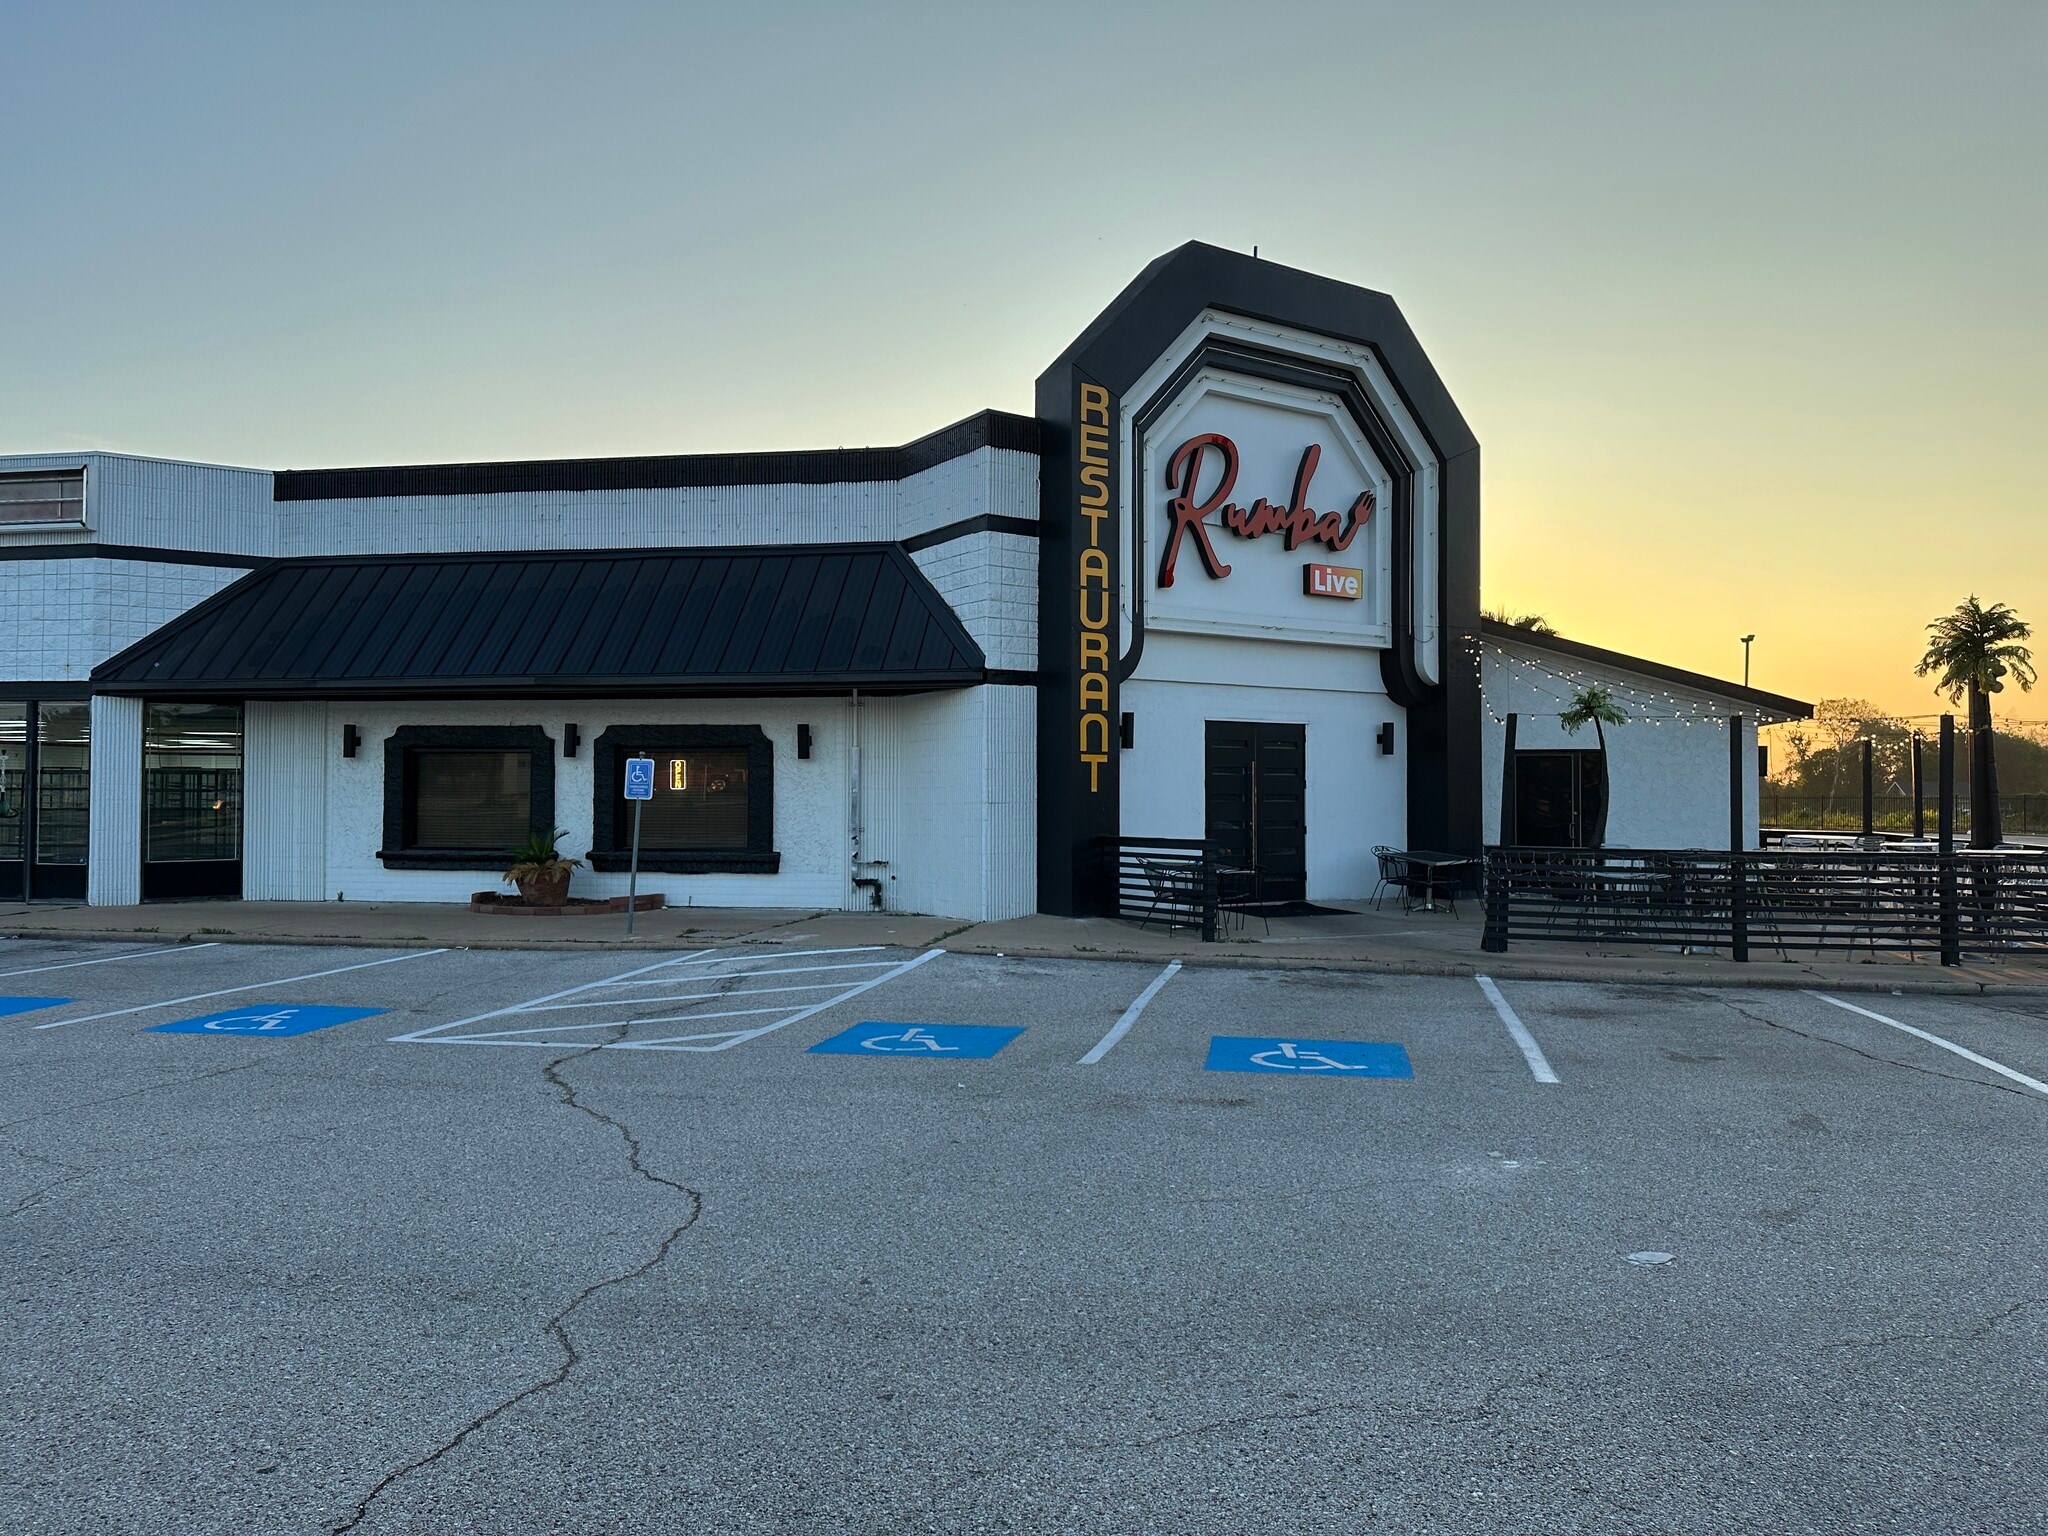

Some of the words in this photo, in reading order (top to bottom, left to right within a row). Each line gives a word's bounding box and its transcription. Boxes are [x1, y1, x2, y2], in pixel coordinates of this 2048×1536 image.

[1079, 383, 1109, 792] RESTAURANT
[1158, 433, 1376, 588] Rumba
[1314, 568, 1359, 595] Live
